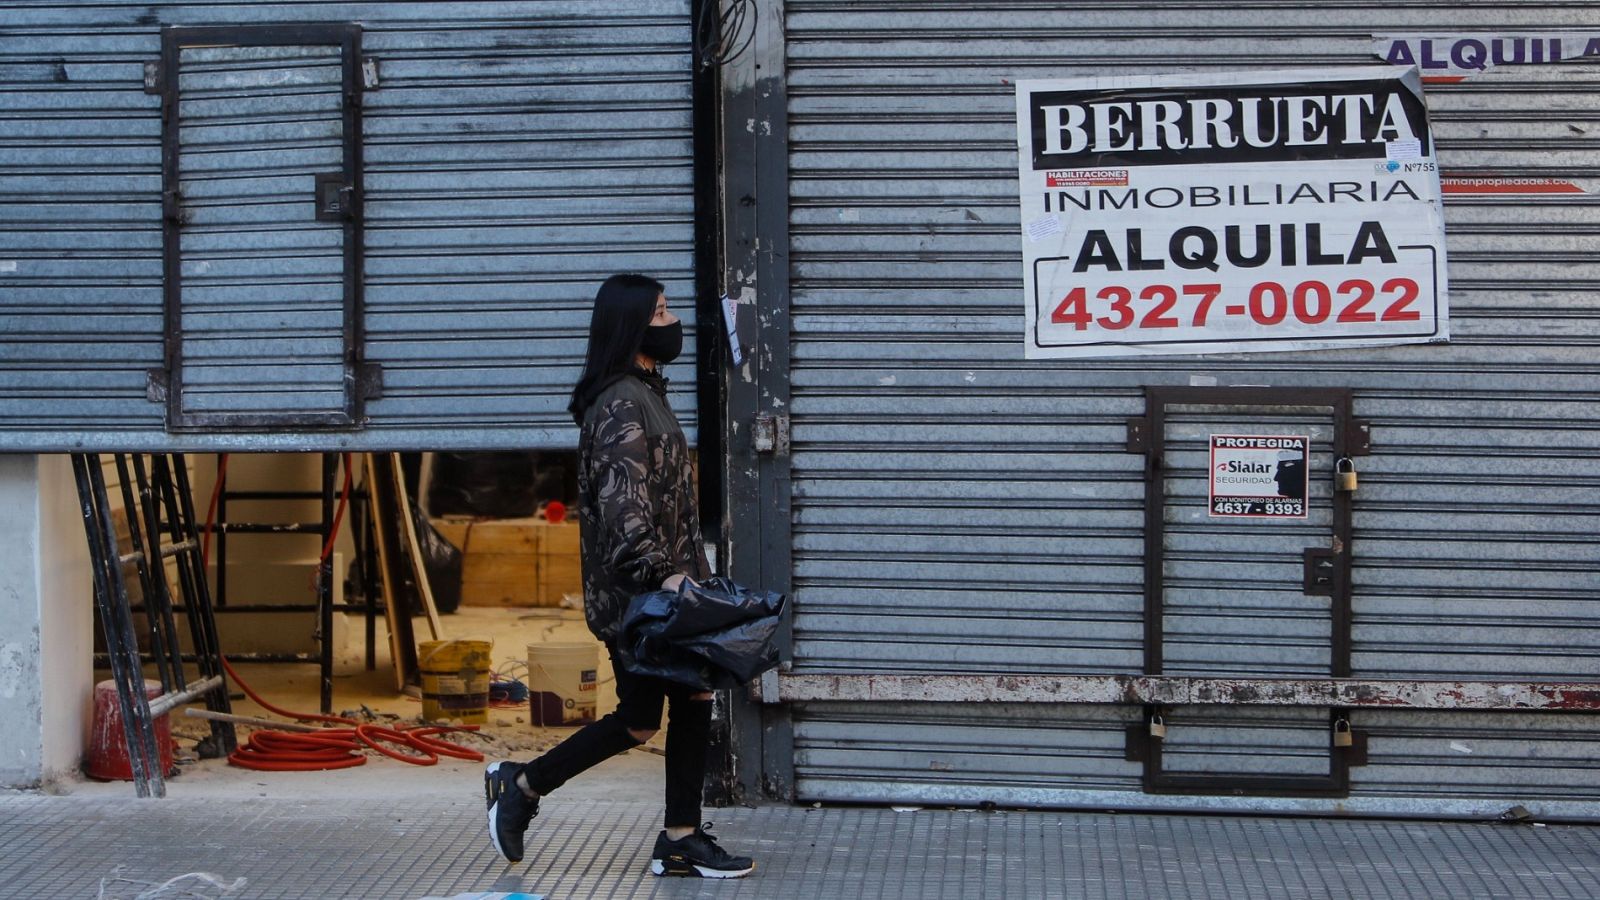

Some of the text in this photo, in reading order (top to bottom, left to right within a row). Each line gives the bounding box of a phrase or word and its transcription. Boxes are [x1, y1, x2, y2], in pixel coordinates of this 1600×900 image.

[1040, 92, 1421, 156] BERRUETA
[1044, 180, 1420, 213] INMOBILIARIA
[1072, 221, 1397, 273] ALQUILA
[1051, 277, 1420, 331] 4327-0022
[1216, 438, 1303, 448] PROTEGIDA
[1228, 461, 1272, 473] Sialar
[1216, 477, 1272, 485] SEGURIDAD
[1214, 503, 1252, 514] 4637
[1265, 503, 1302, 515] 9393
